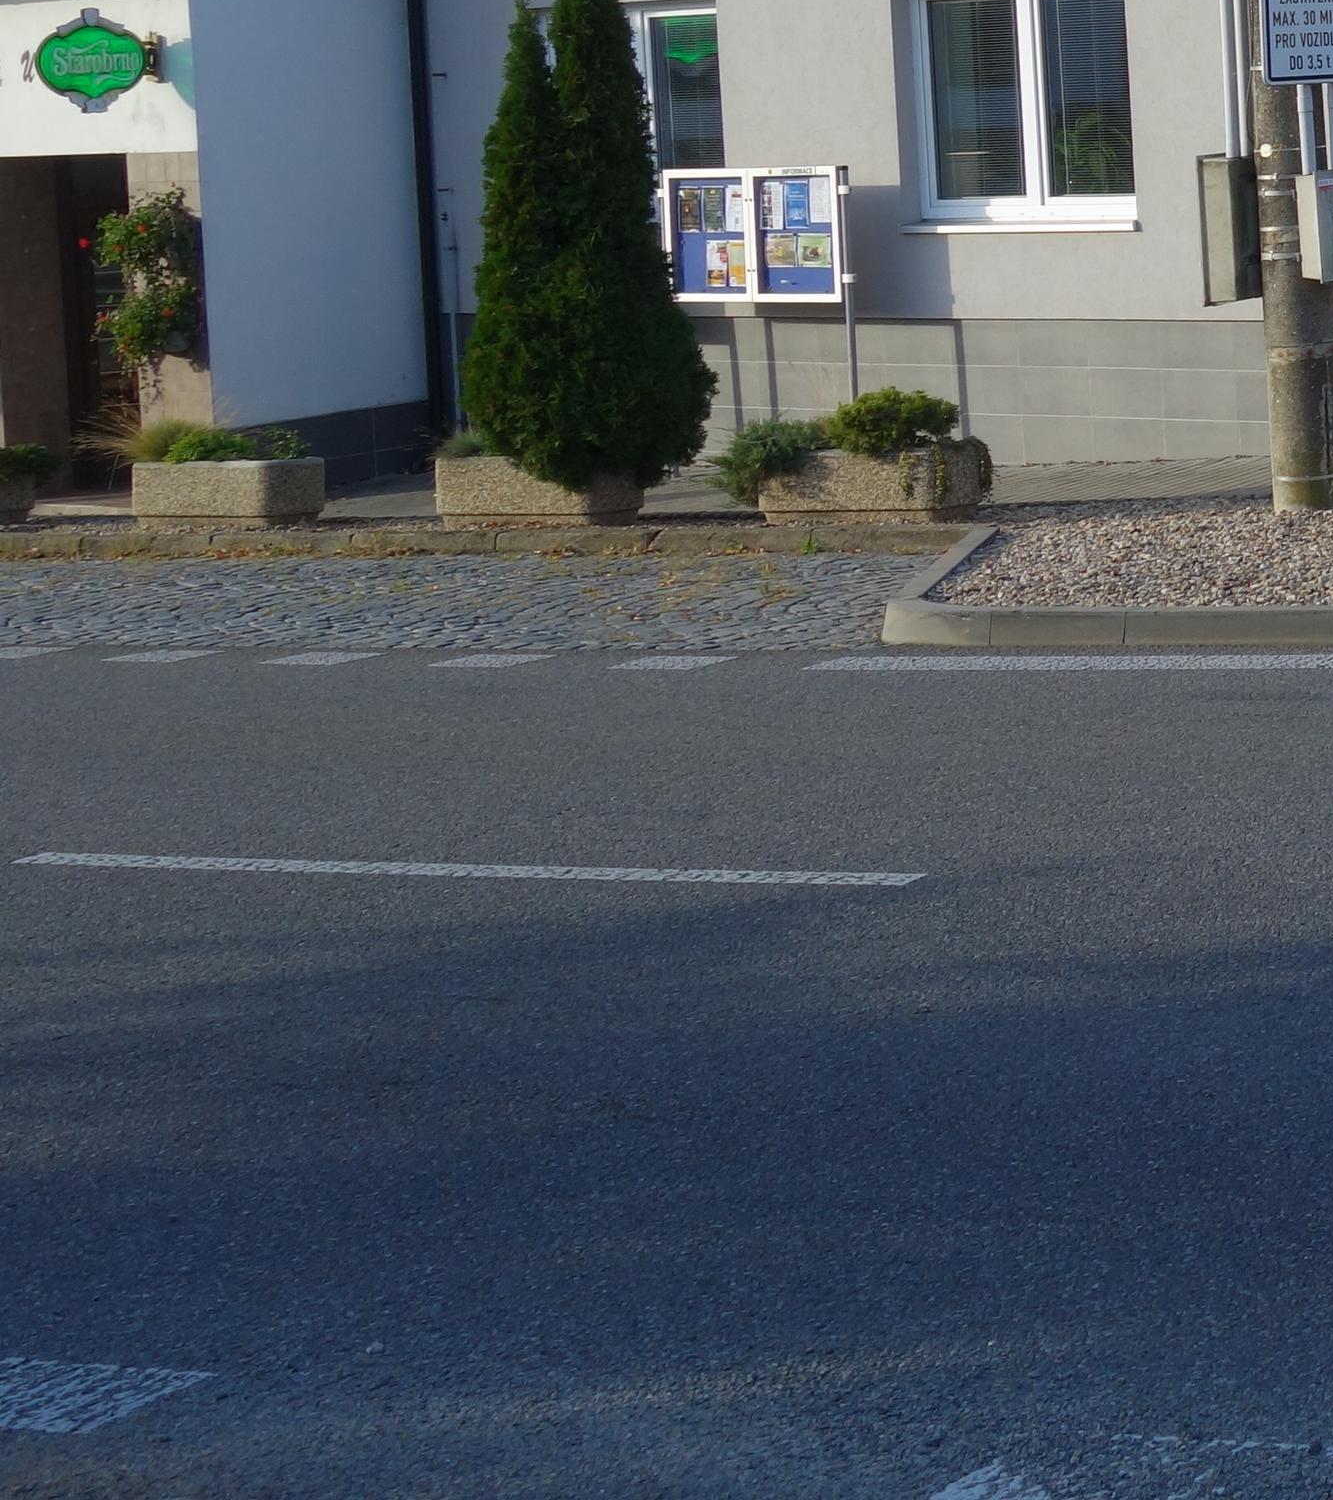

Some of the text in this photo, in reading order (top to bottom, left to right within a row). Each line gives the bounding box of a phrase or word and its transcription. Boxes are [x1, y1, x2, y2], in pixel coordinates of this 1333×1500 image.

[1272, 11, 1300, 26] MAX.
[1303, 10, 1316, 25] 30
[1275, 33, 1296, 49] PRO
[53, 40, 140, 84] Starobrno
[1289, 54, 1331, 70] DO 3,5 t
